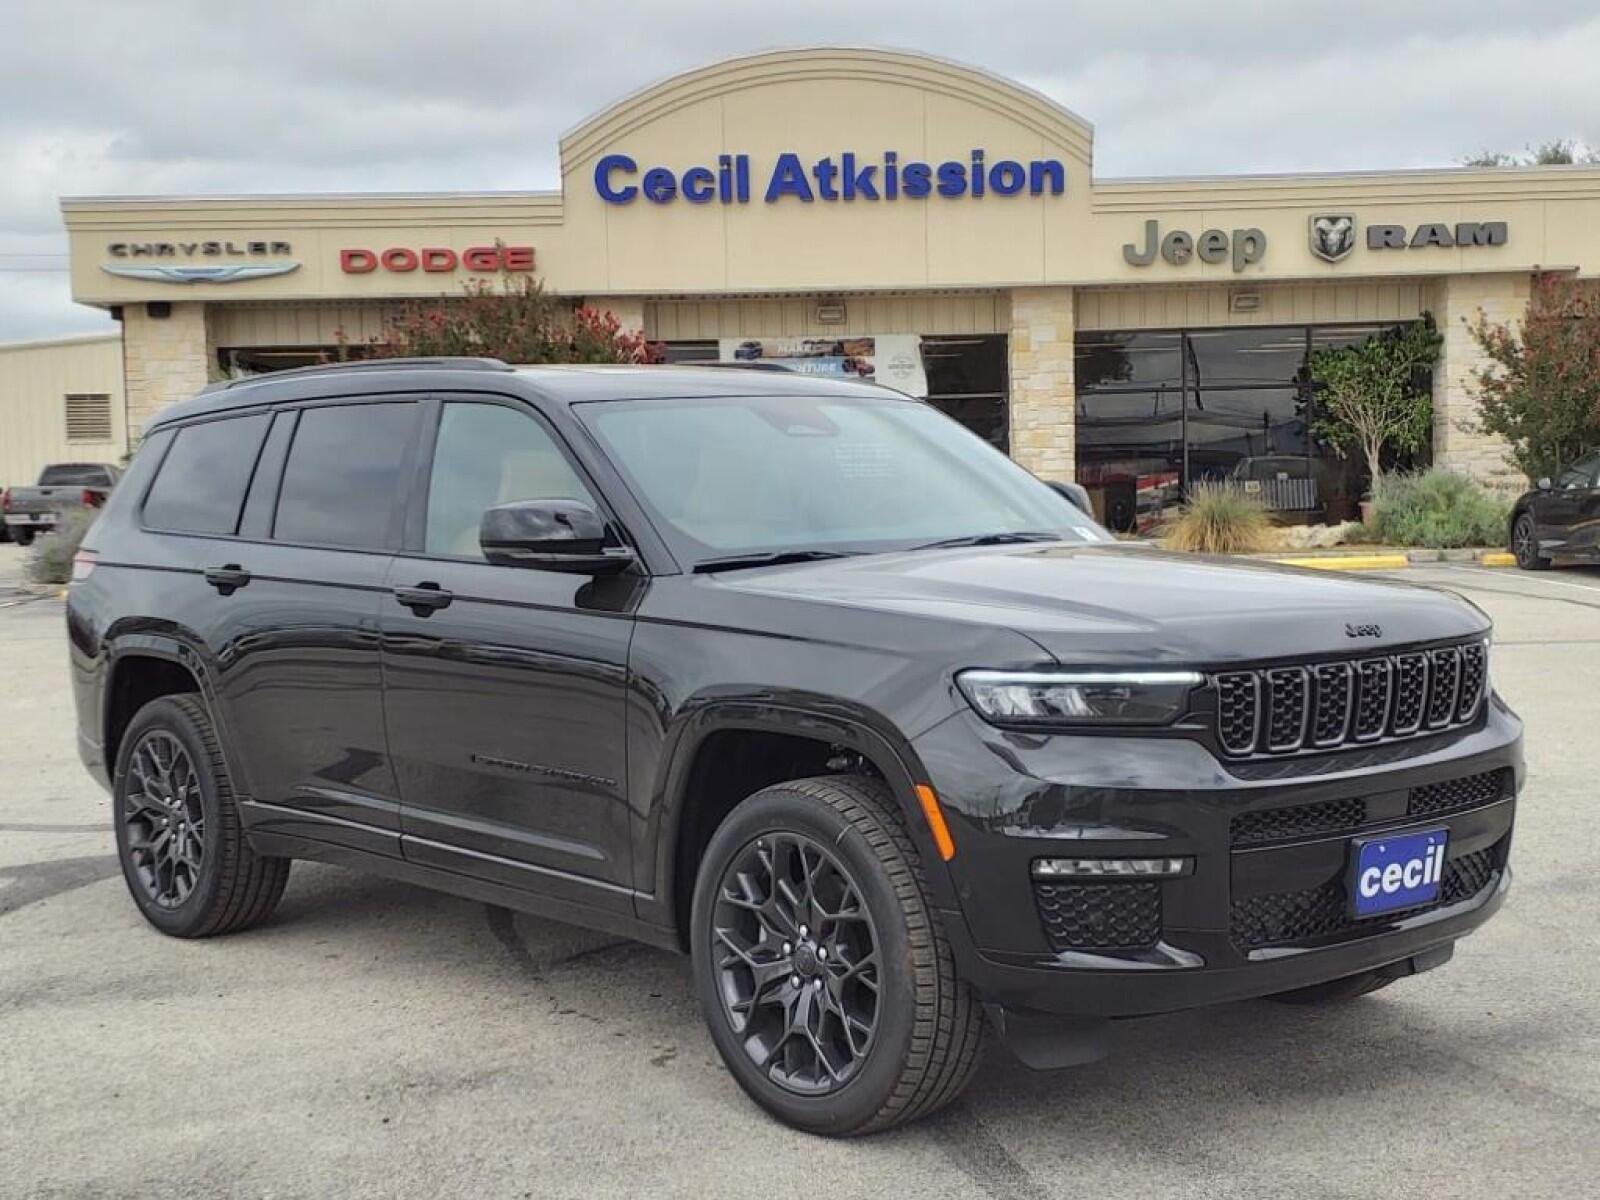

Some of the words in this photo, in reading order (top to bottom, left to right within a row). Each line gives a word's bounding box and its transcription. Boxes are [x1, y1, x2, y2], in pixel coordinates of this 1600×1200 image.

[594, 153, 750, 204] Cecil
[764, 149, 1065, 202] Atkission
[108, 241, 292, 258] CHRYSLER
[1122, 219, 1267, 273] Jeep
[1366, 222, 1508, 250] RAM
[340, 247, 536, 273] DODGE
[1344, 623, 1383, 638] Jeep
[1360, 845, 1445, 898] cecil
